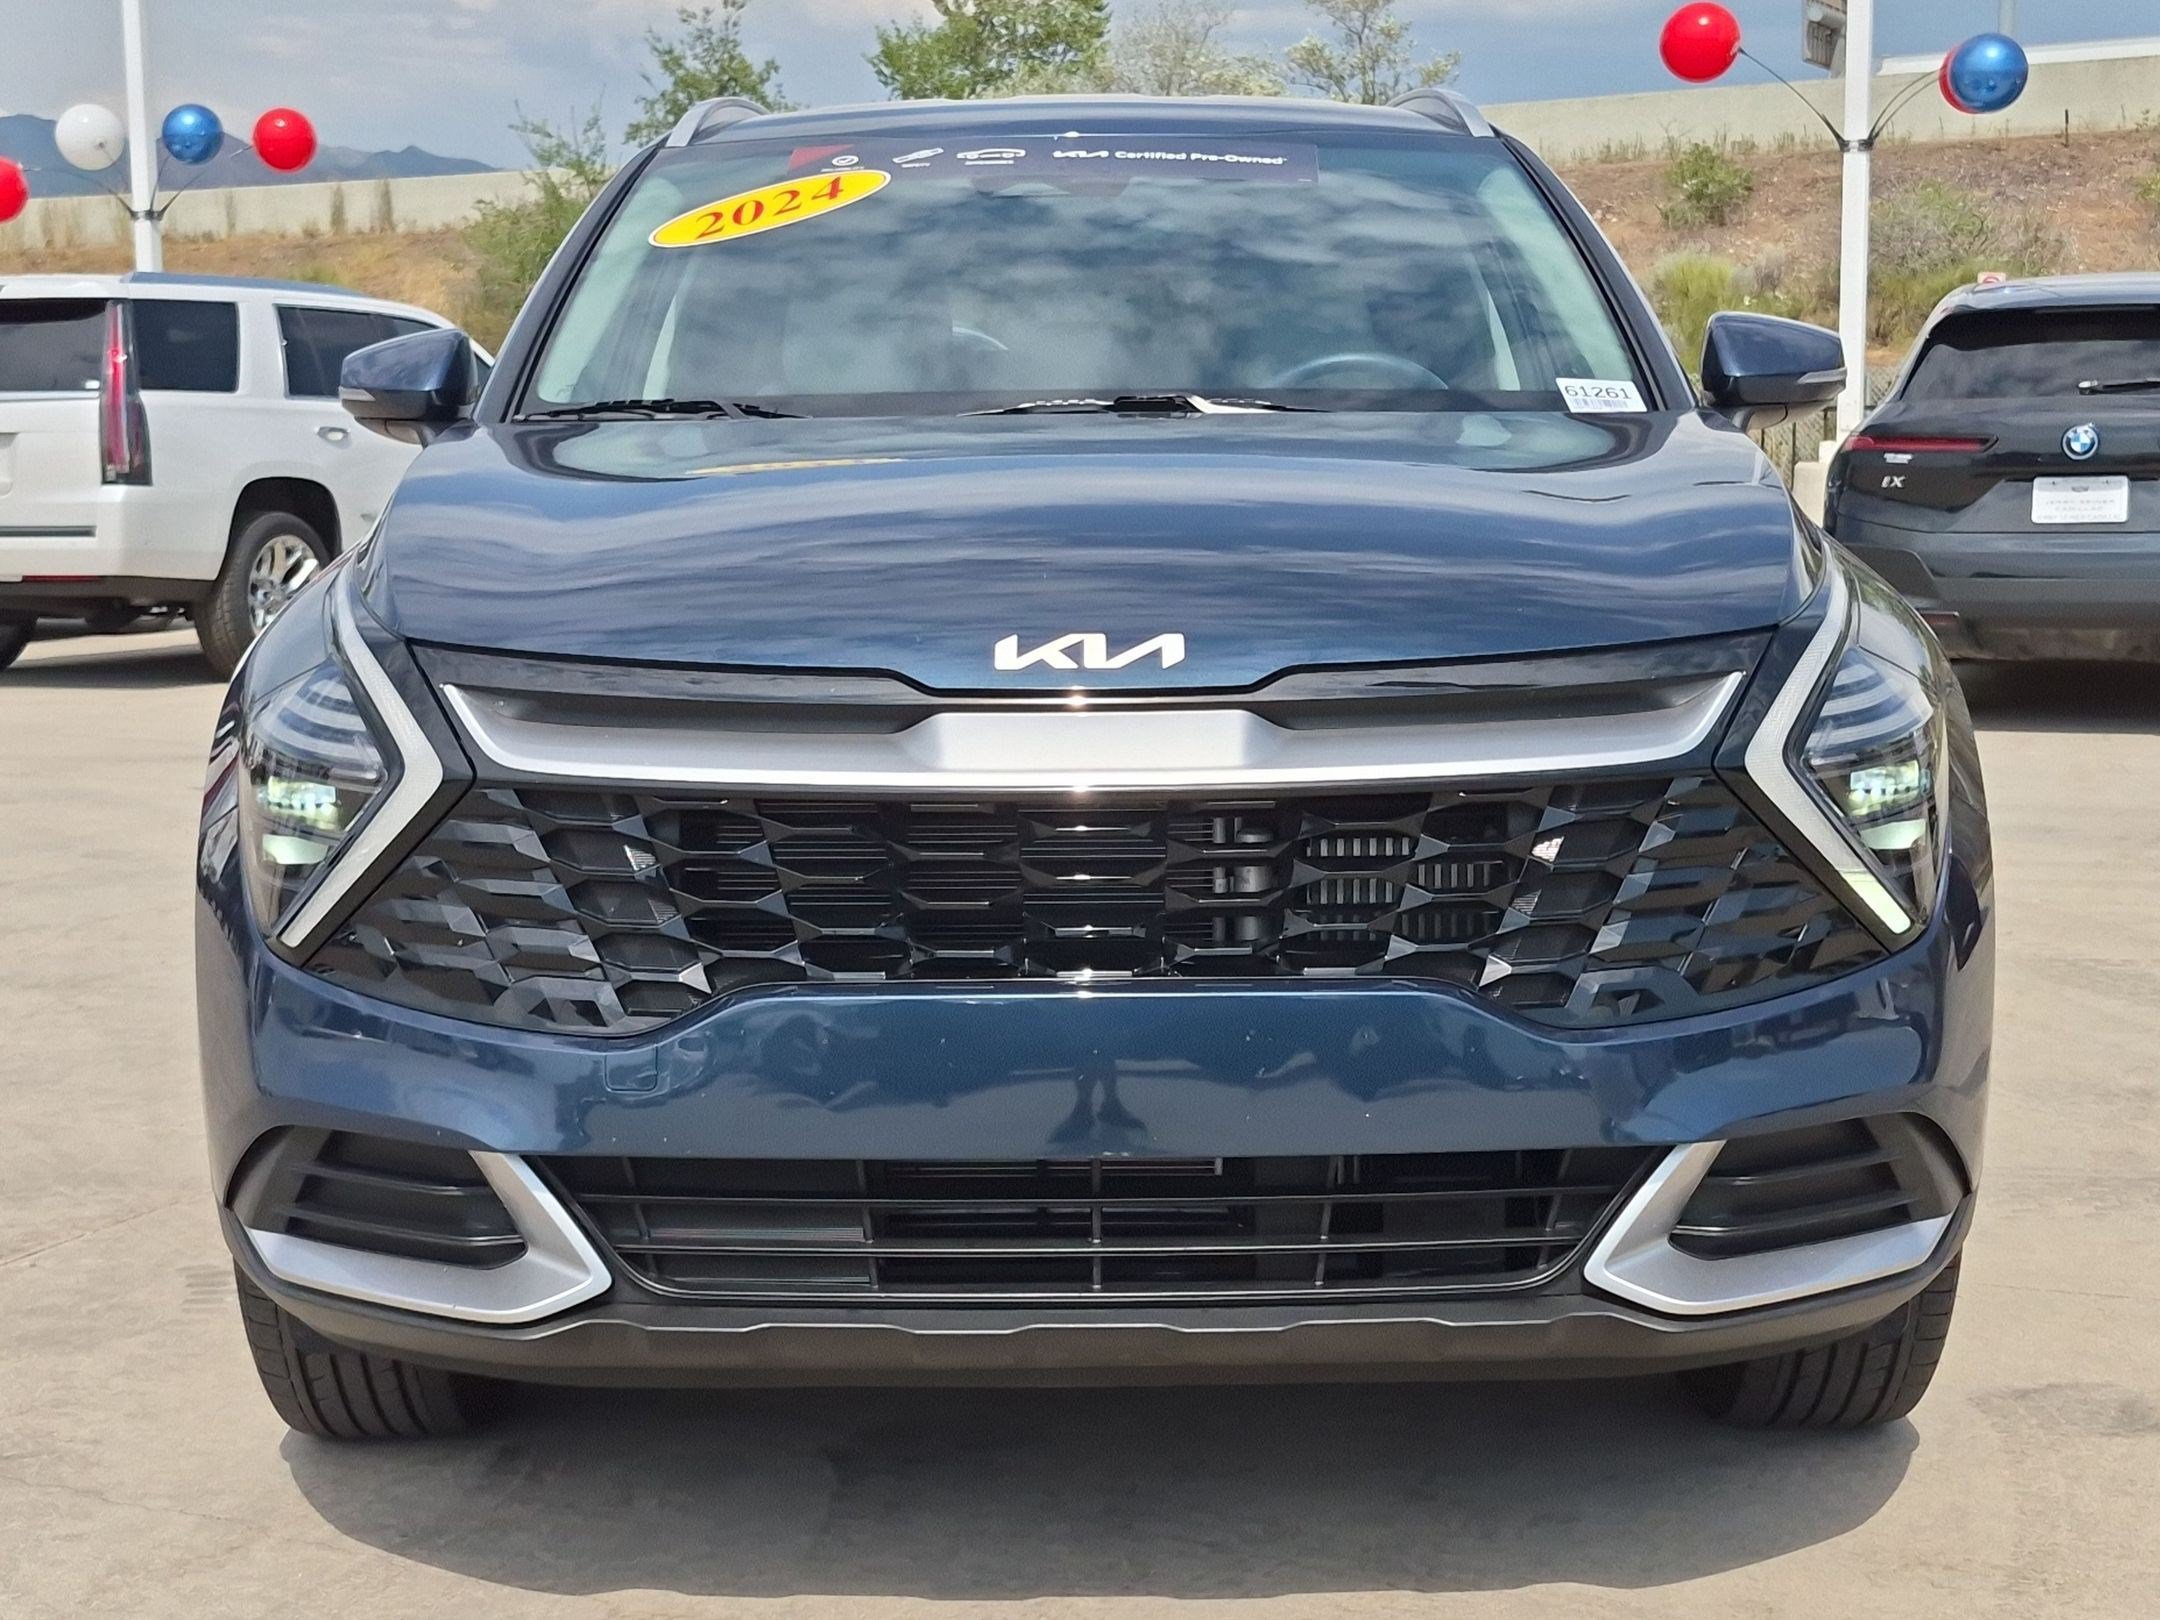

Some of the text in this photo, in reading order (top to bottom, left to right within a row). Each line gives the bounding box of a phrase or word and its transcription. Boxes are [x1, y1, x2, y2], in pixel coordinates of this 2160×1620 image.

[1115, 151, 1187, 160] Certified
[1190, 152, 1283, 164] Pre-Owned
[696, 176, 844, 239] 2024
[1566, 386, 1631, 399] 61261
[994, 633, 1185, 670] KIA
